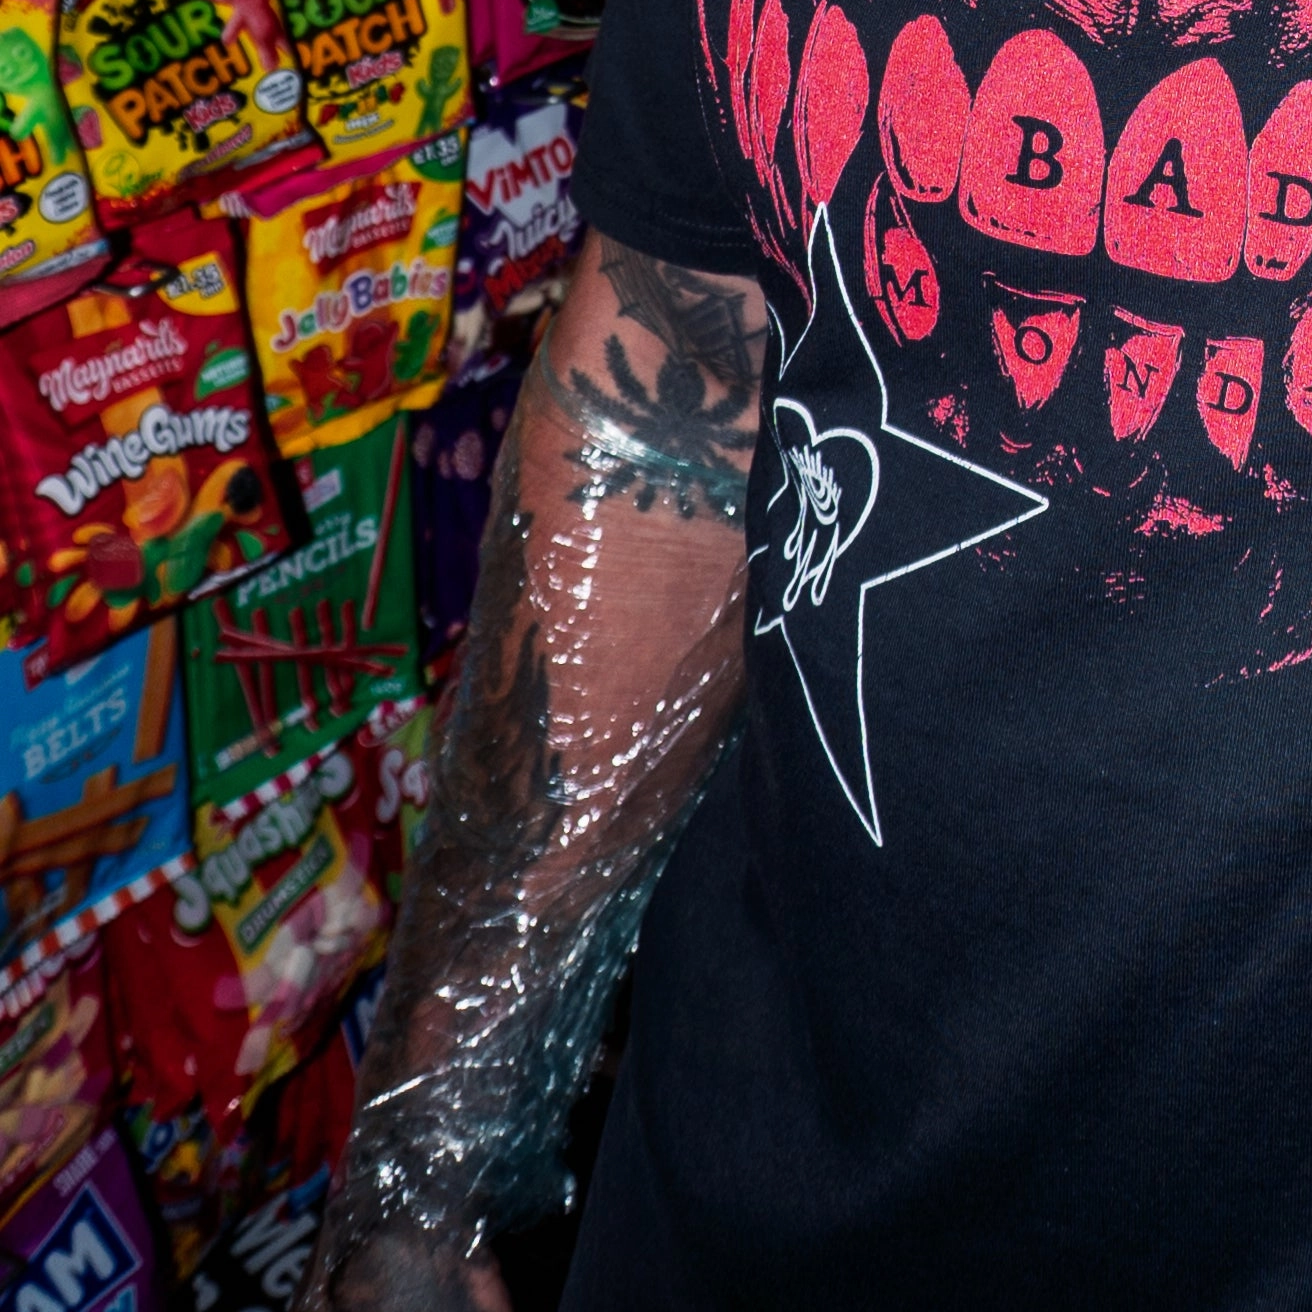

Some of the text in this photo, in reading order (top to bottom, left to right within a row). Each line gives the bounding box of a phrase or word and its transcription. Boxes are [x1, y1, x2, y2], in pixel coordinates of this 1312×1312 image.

[106, 39, 251, 143] PATCH
[183, 90, 239, 133] Kids
[346, 50, 404, 89] Kids
[467, 136, 575, 212] VIMTO
[486, 198, 581, 260] Juicy
[273, 292, 352, 353] Jelly
[347, 258, 449, 316] Babies
[39, 316, 189, 412] Maynards
[35, 404, 251, 516] Wine Gums
[236, 517, 378, 609] PENCILS
[22, 685, 128, 780] BELTS
